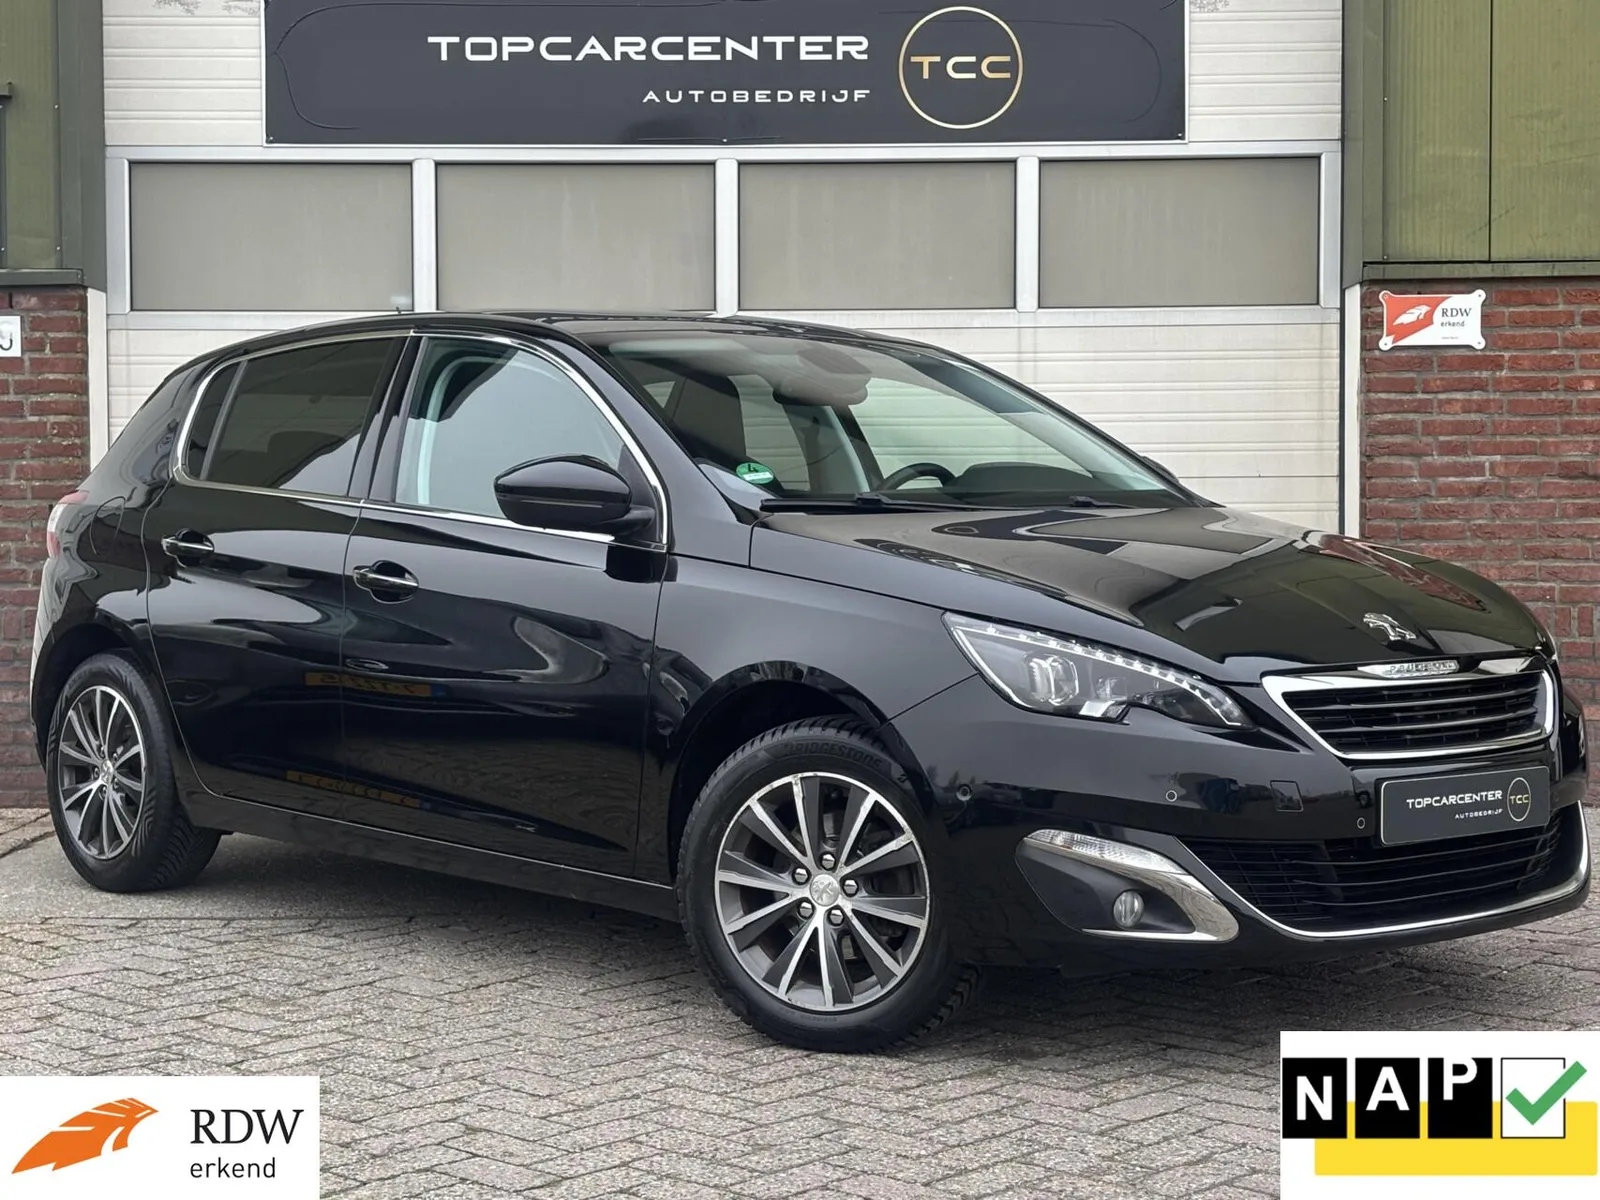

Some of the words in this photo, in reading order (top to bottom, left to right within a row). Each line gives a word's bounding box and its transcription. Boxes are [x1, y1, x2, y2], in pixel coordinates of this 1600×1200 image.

[427, 35, 869, 62] TOPCARCENTER
[910, 55, 1011, 79] TCC
[642, 89, 871, 104] AUTOBEDRIJF
[1441, 307, 1472, 318] RDW
[1440, 320, 1465, 328] erkend
[1406, 790, 1503, 809] TOPCARCENTER
[1509, 794, 1530, 805] TCC
[1454, 808, 1504, 819] AUTOBEDRIJF
